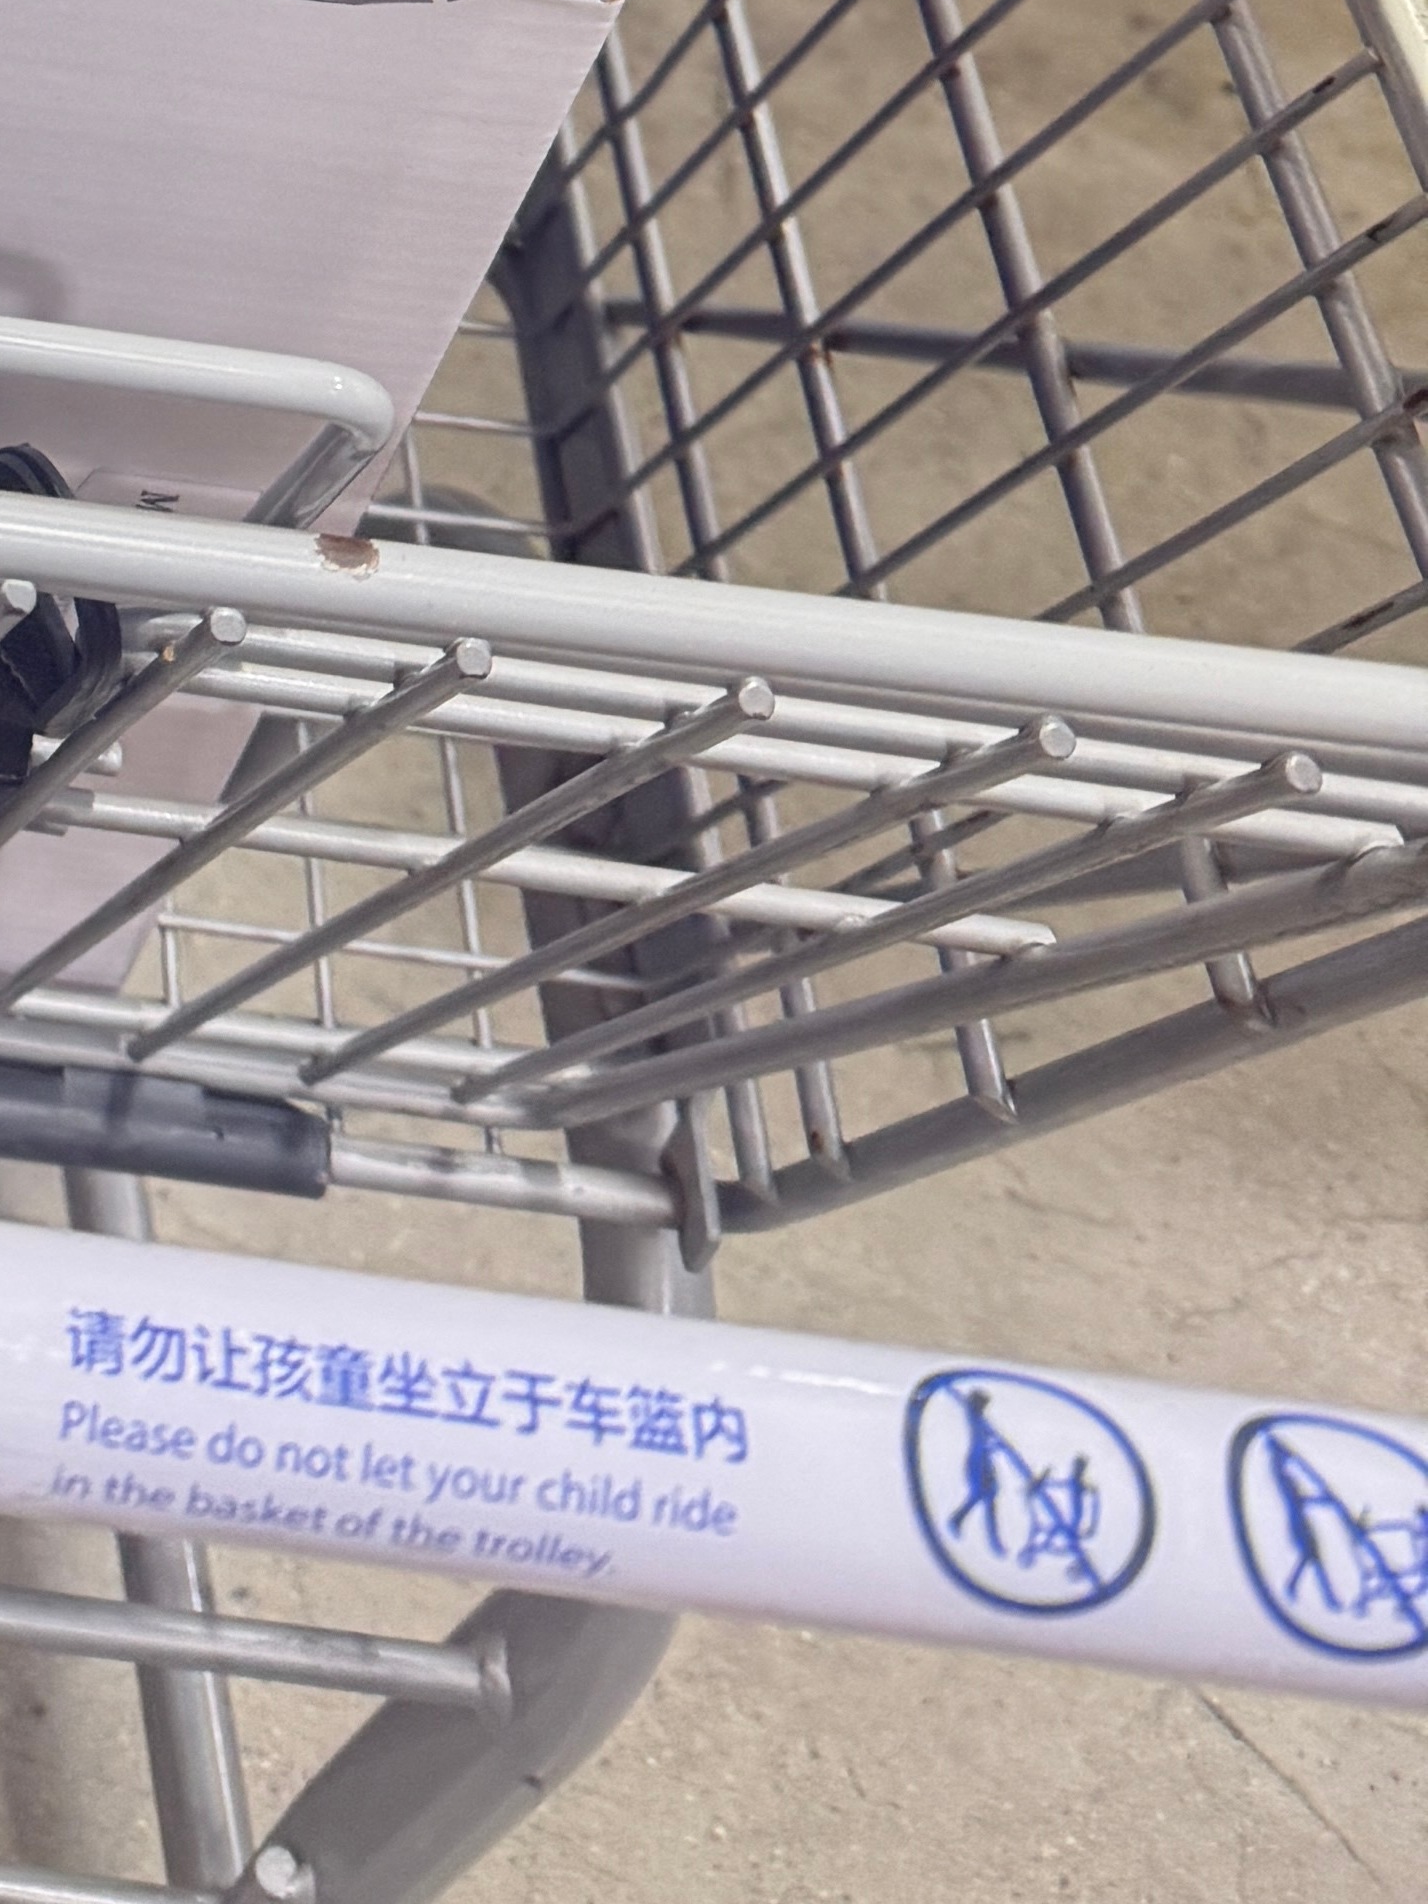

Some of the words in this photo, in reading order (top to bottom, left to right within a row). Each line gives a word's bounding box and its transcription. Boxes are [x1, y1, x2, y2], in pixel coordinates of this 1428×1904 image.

[64, 1306, 753, 1465] 请勿让孩童坐立于车篮内
[50, 1463, 95, 1502] in
[101, 1469, 178, 1511] the
[184, 1479, 328, 1535] basket
[332, 1505, 385, 1543] of
[387, 1509, 465, 1555] the
[471, 1526, 620, 1580] trolley.
[58, 1400, 198, 1459] Please
[205, 1420, 267, 1471] do
[273, 1434, 351, 1484] not
[358, 1438, 419, 1492] let
[423, 1463, 528, 1510] your
[533, 1467, 644, 1526] child
[649, 1484, 740, 1537] ride
